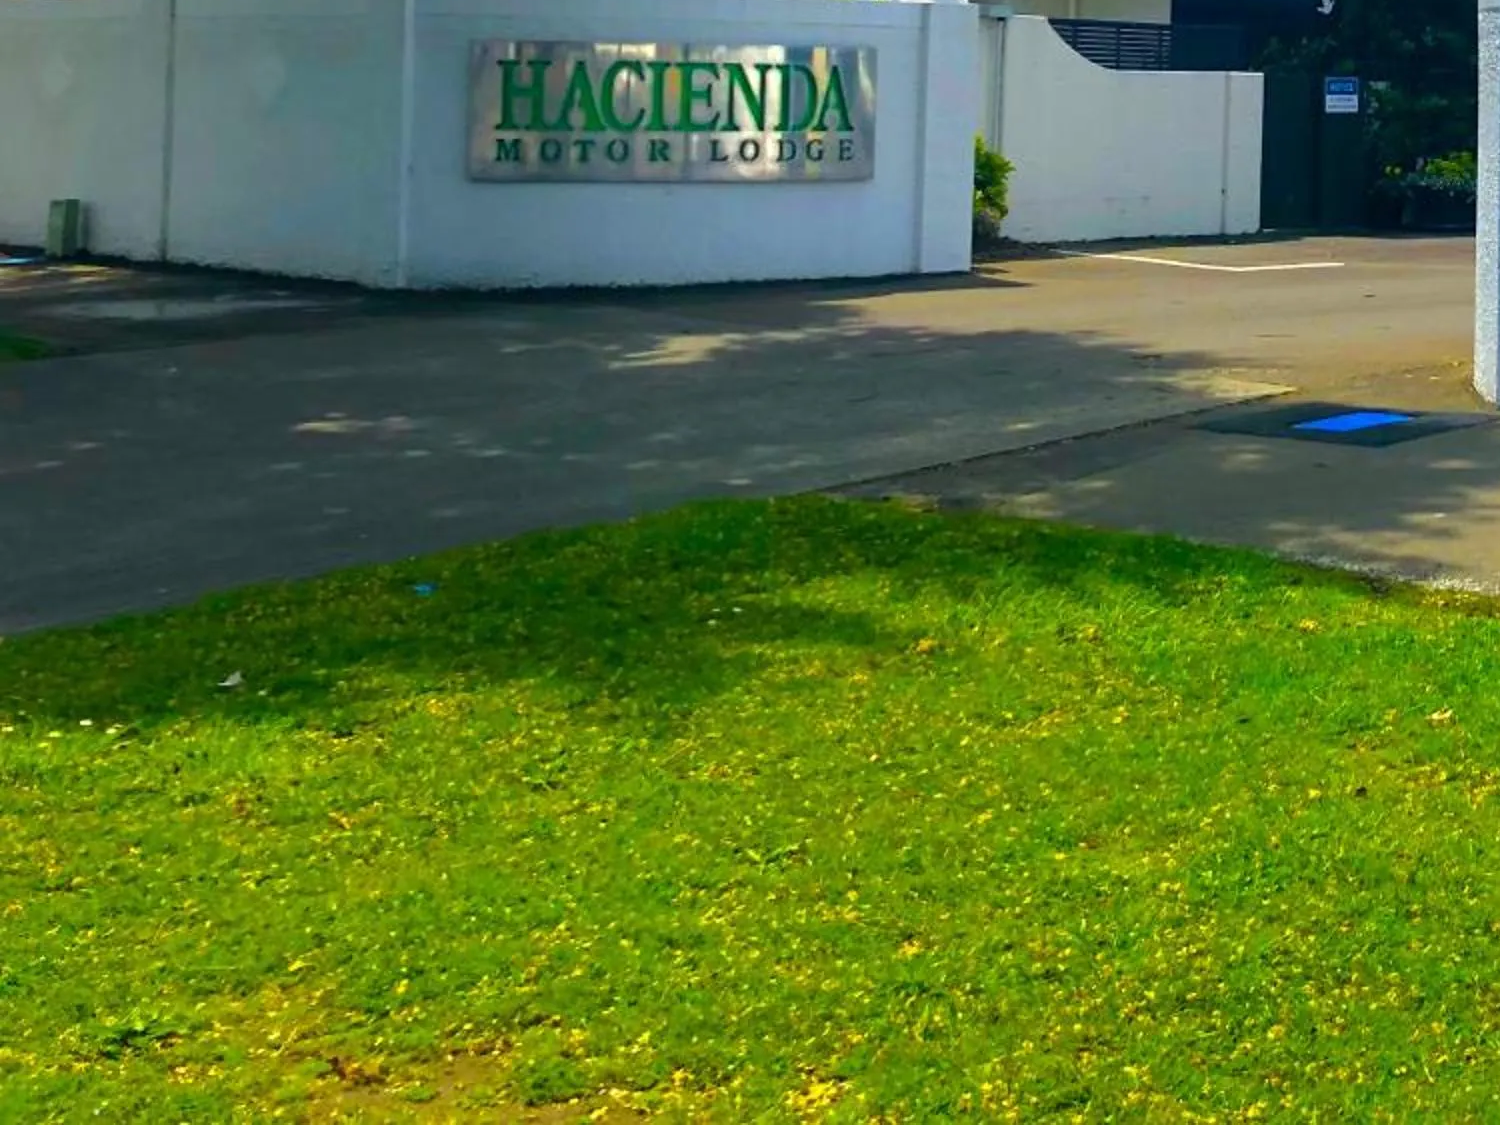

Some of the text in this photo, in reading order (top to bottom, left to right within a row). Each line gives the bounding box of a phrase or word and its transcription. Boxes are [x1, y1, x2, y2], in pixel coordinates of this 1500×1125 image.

[494, 60, 855, 133] HACIENDA
[494, 138, 855, 163] MOTOR LODGE
